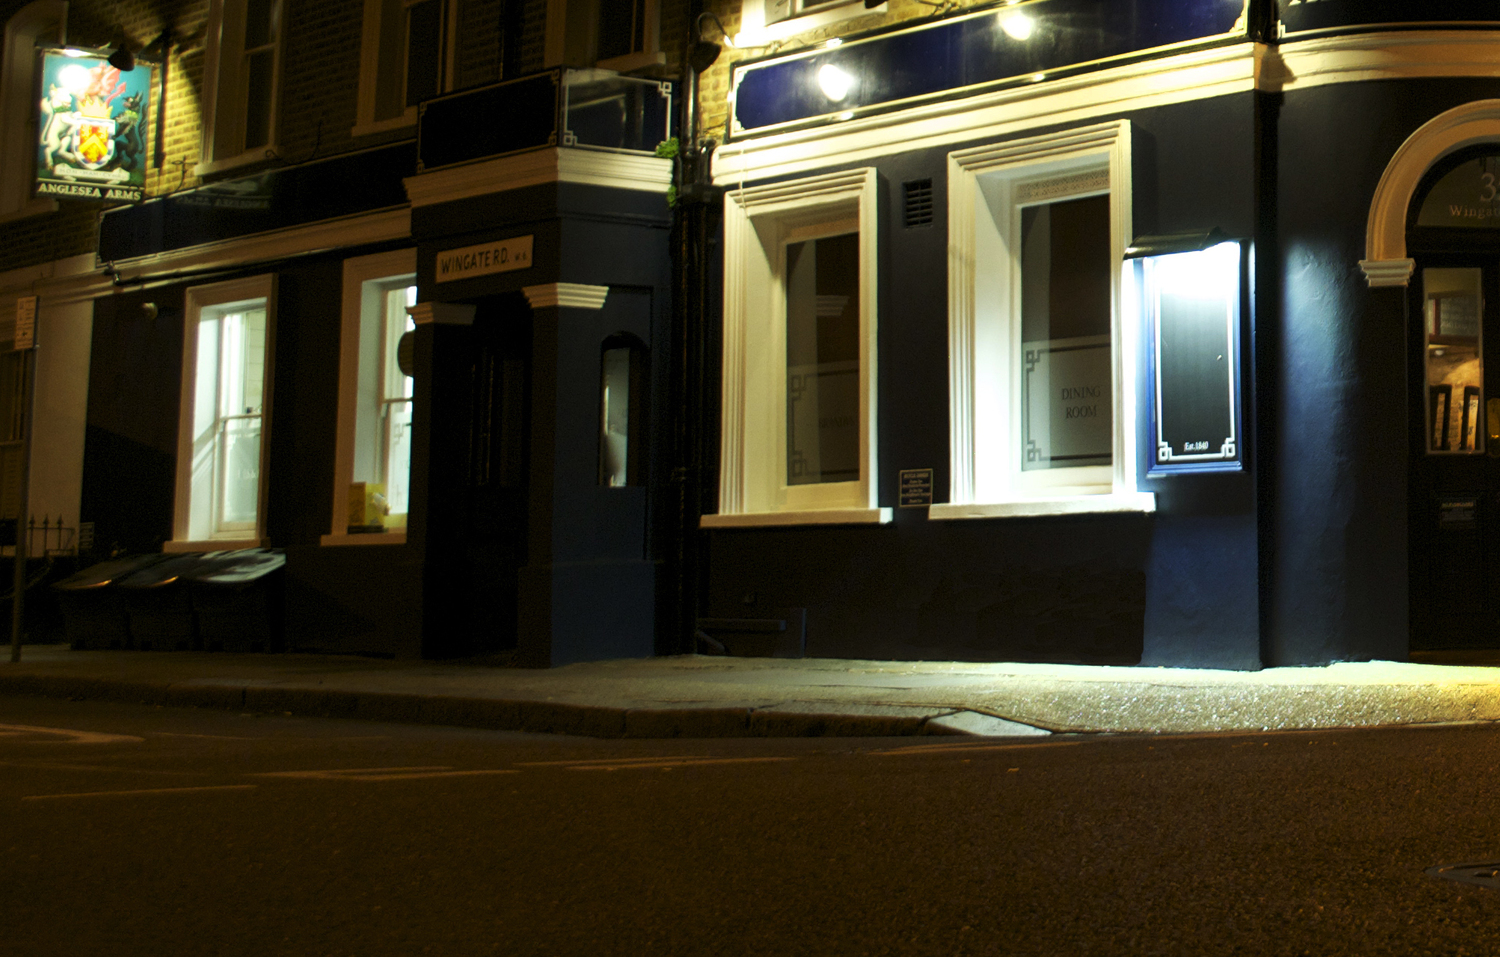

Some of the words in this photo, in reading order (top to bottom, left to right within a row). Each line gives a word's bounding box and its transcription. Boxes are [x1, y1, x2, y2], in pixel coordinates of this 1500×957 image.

[38, 183, 101, 198] ANGLESEA
[104, 189, 141, 201] ARMS
[441, 250, 491, 274] WINGATE
[1061, 385, 1101, 400] DINING
[1065, 404, 1097, 419] ROOM
